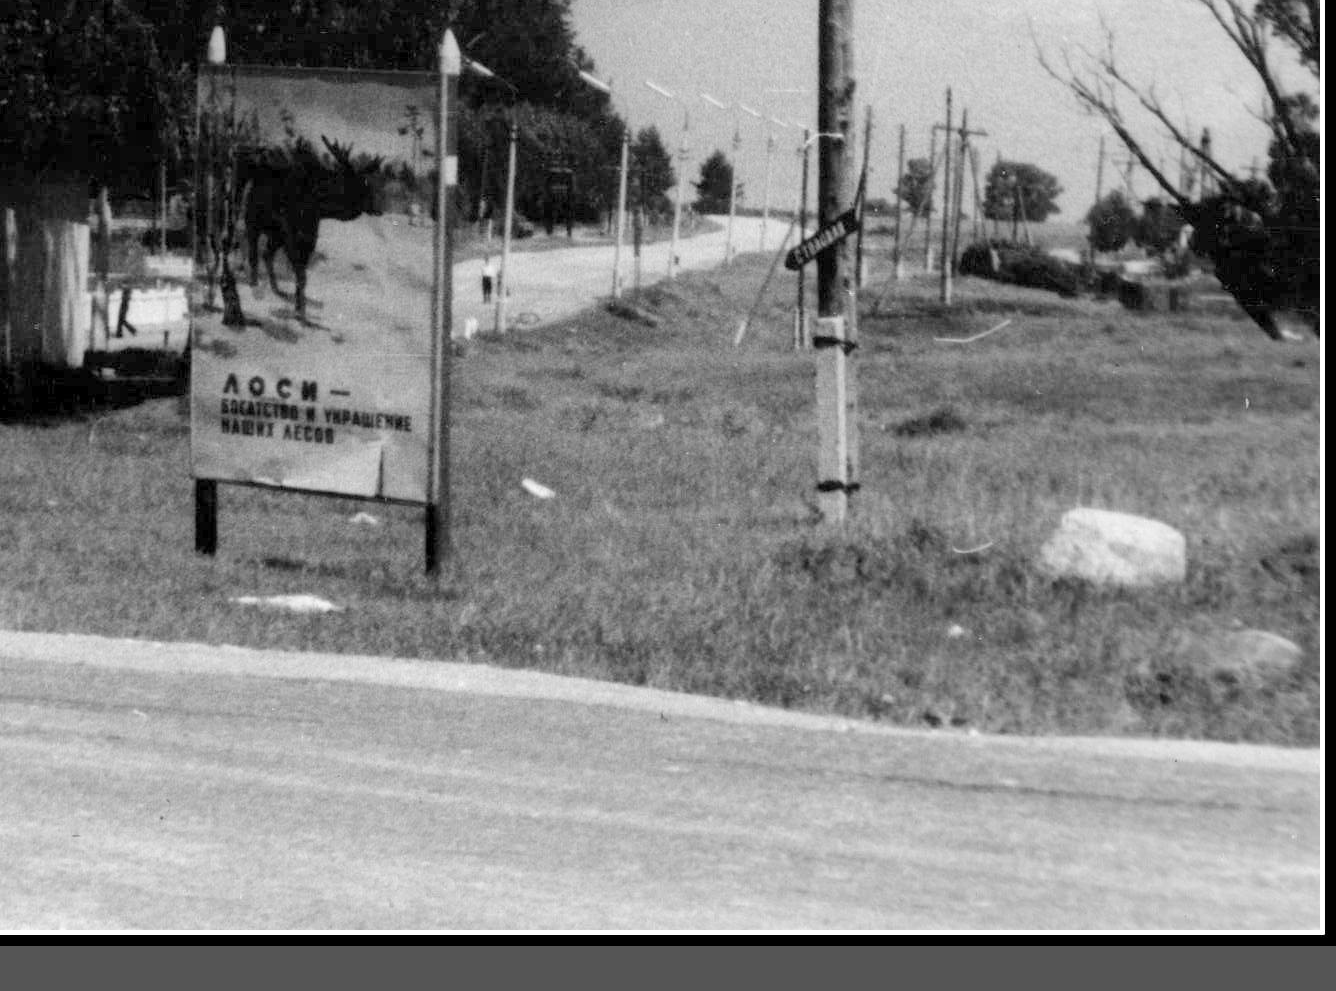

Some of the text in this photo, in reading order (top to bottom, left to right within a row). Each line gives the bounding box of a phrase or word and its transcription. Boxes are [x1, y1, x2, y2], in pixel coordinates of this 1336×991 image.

[222, 373, 317, 401] ЛОСИ
[221, 418, 334, 444] НАШИХ ЛЕСОВ
